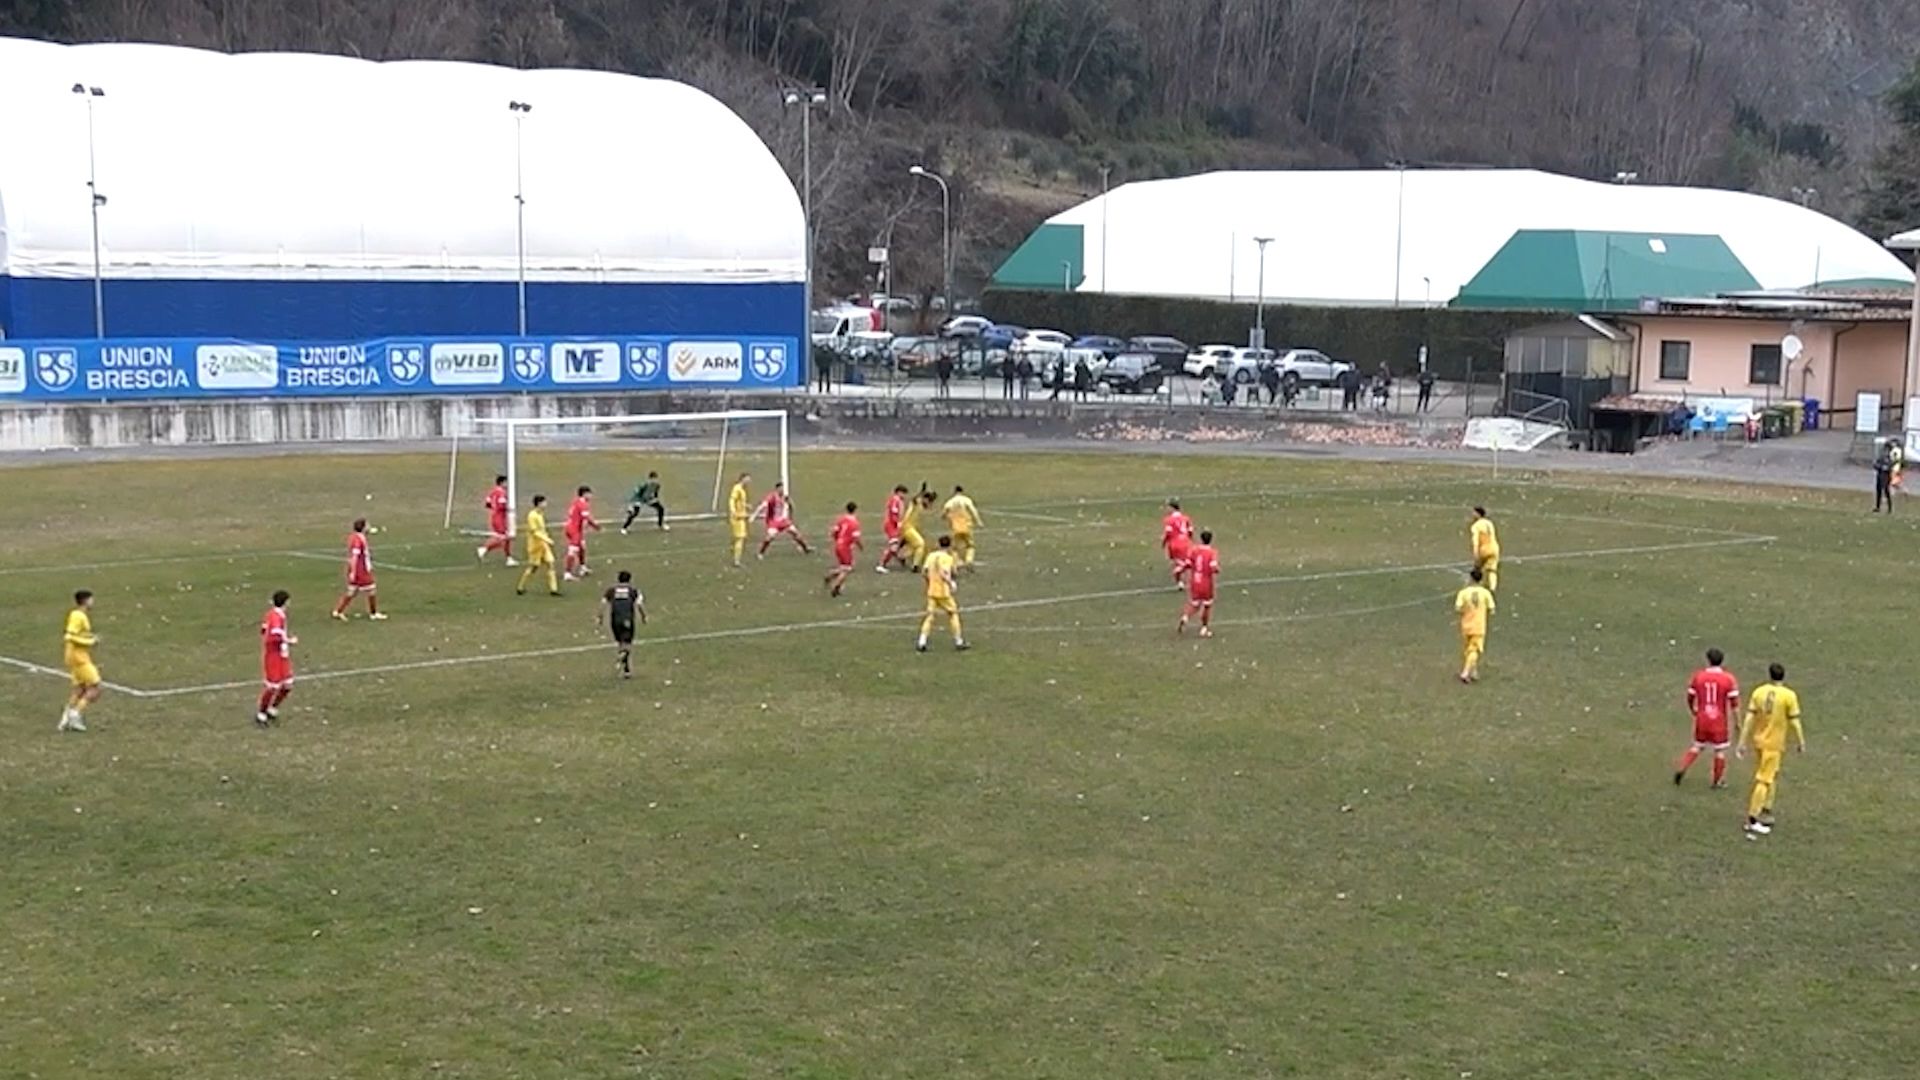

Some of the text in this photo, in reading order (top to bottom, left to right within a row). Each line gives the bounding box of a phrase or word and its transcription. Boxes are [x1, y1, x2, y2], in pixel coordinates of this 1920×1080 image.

[101, 346, 172, 367] UNION
[300, 345, 366, 365] UNION
[453, 354, 498, 367] VIBI
[565, 349, 604, 373] MF
[702, 356, 739, 369] ARM
[86, 369, 190, 389] BRESCIA
[286, 366, 381, 386] BRESCIA
[1704, 681, 1718, 705] 11
